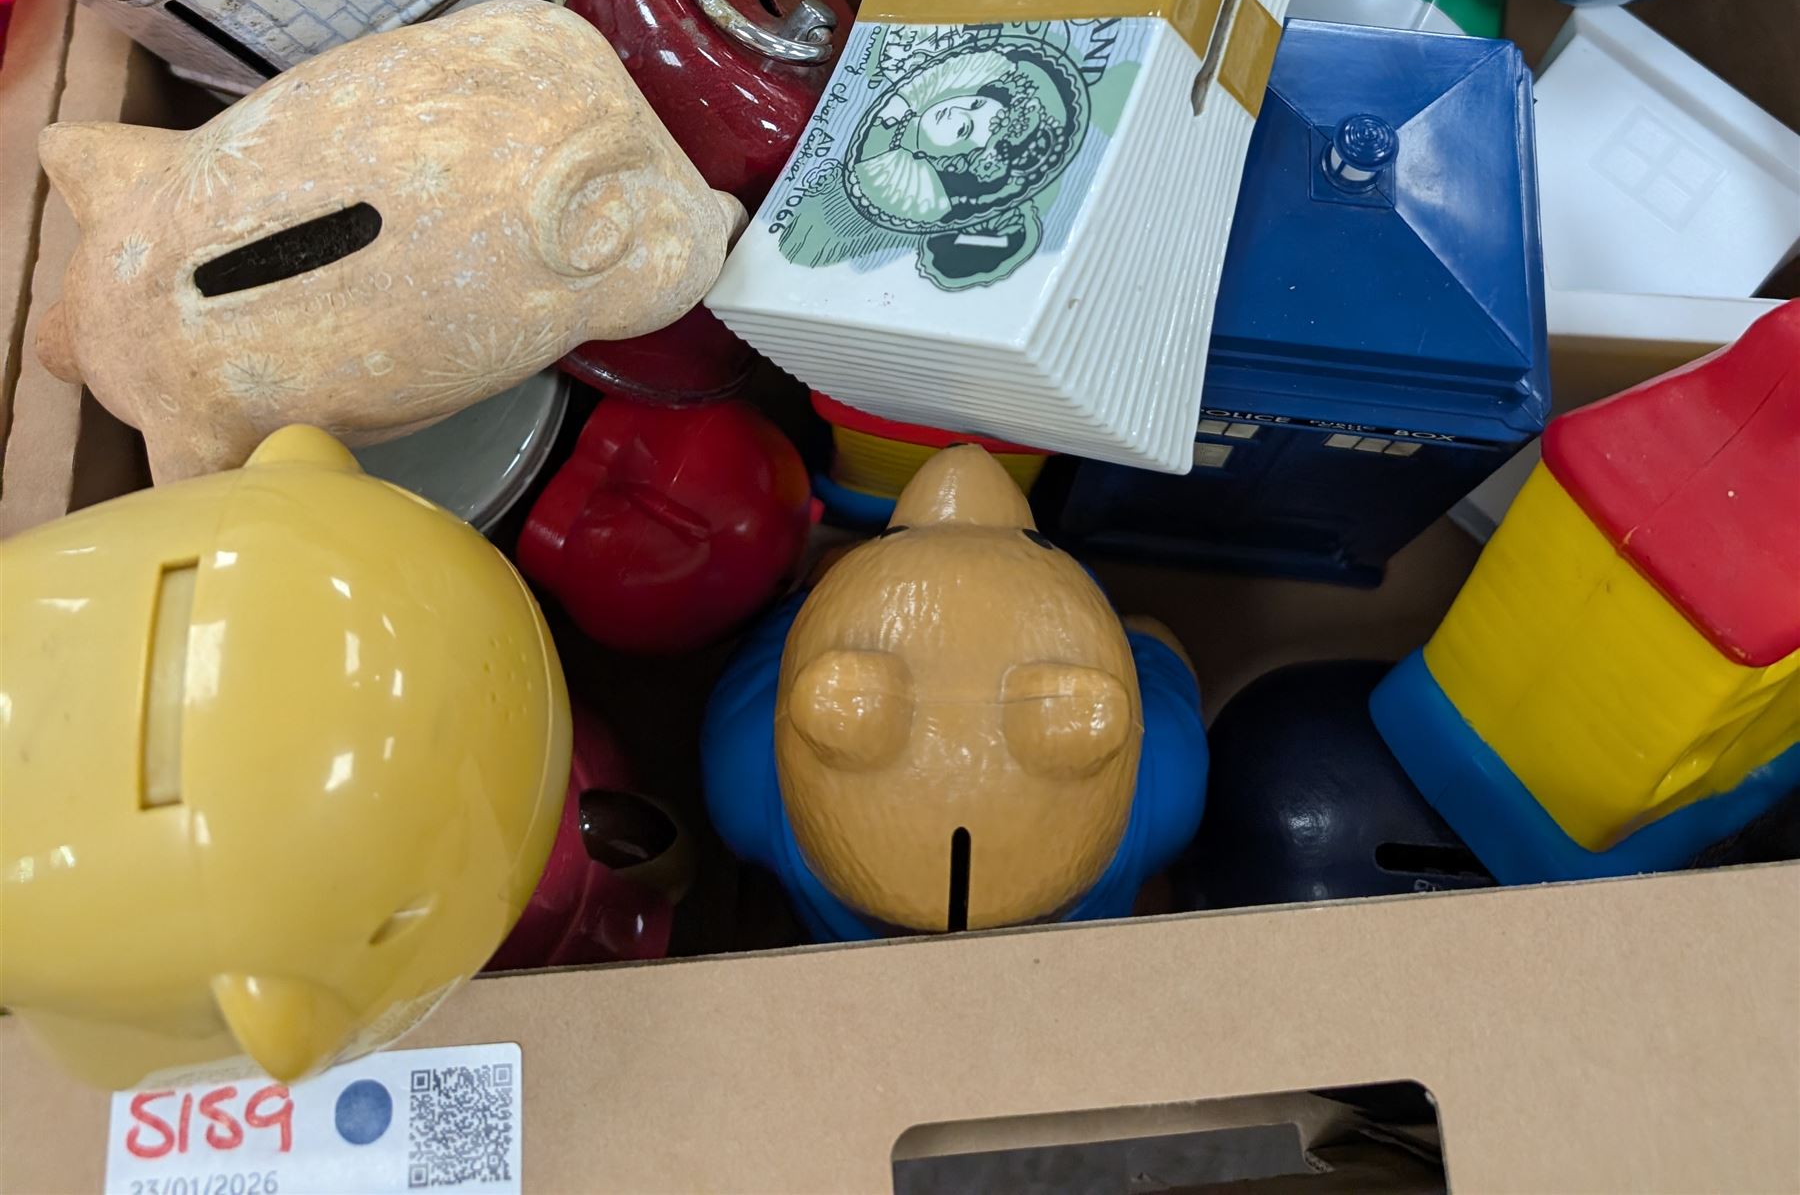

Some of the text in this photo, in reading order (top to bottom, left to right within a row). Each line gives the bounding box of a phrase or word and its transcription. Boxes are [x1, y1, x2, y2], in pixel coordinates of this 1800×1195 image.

[768, 132, 835, 234] AD 1066
[1201, 408, 1292, 422] OLICE
[1393, 429, 1456, 442] BOX
[130, 1171, 278, 1195] 23/01/2026
